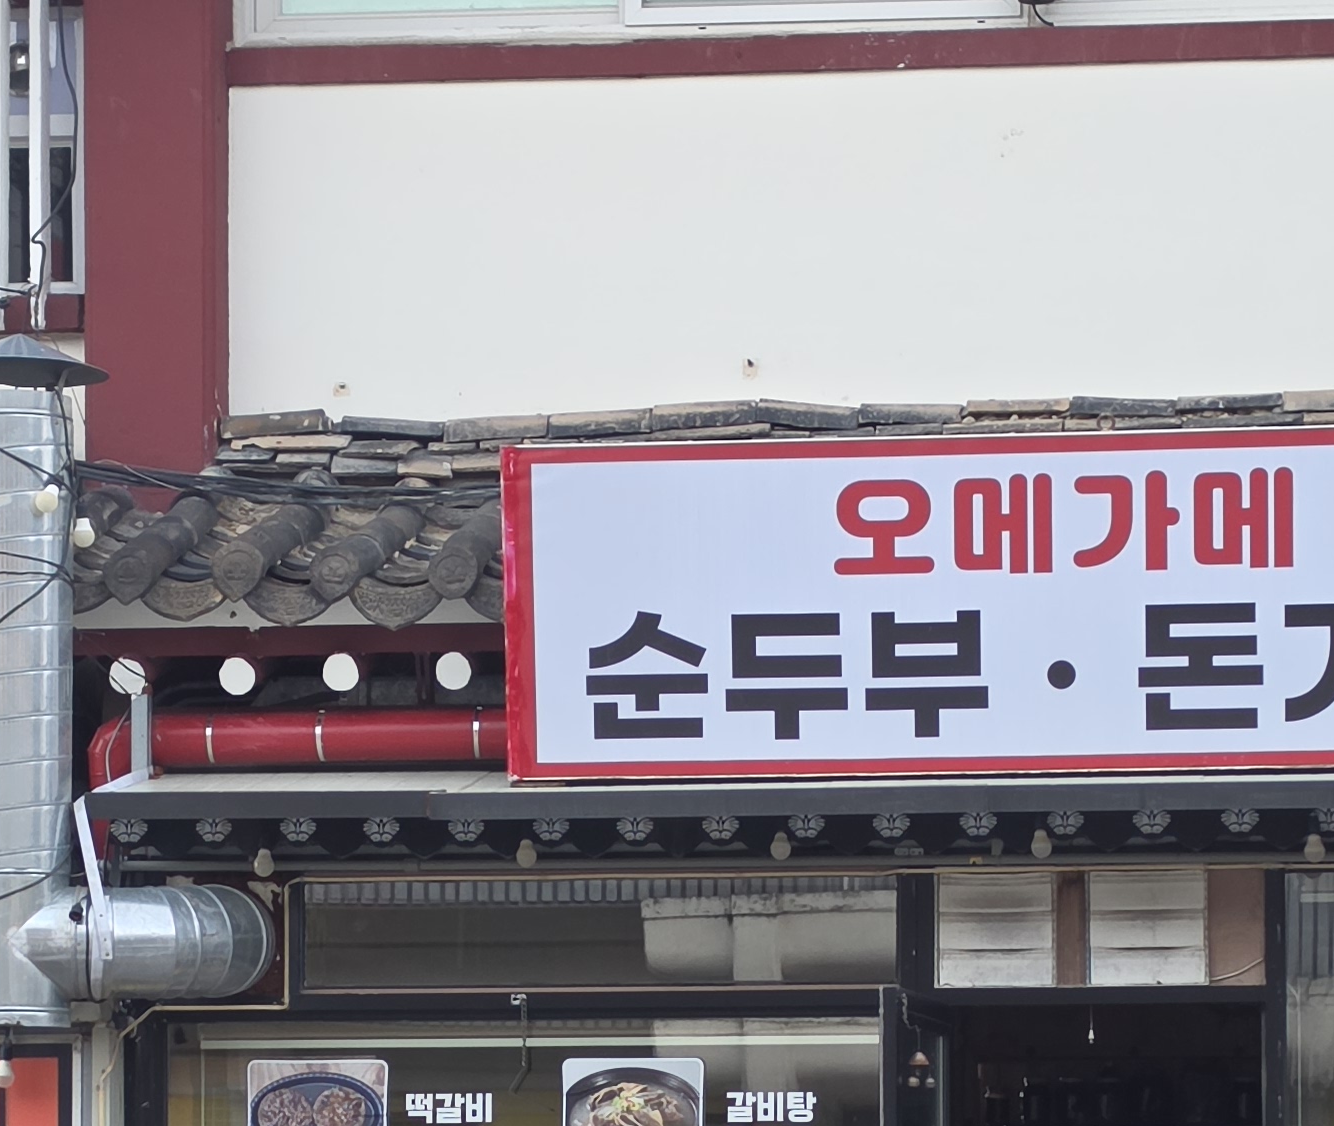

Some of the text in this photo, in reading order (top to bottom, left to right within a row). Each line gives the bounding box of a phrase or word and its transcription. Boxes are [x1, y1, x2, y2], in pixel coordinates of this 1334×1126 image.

[833, 466, 1294, 576] 오메가메
[585, 609, 990, 741] 순두부
[405, 1092, 493, 1124] 떡갈비
[726, 1091, 817, 1123] 갈비탕
